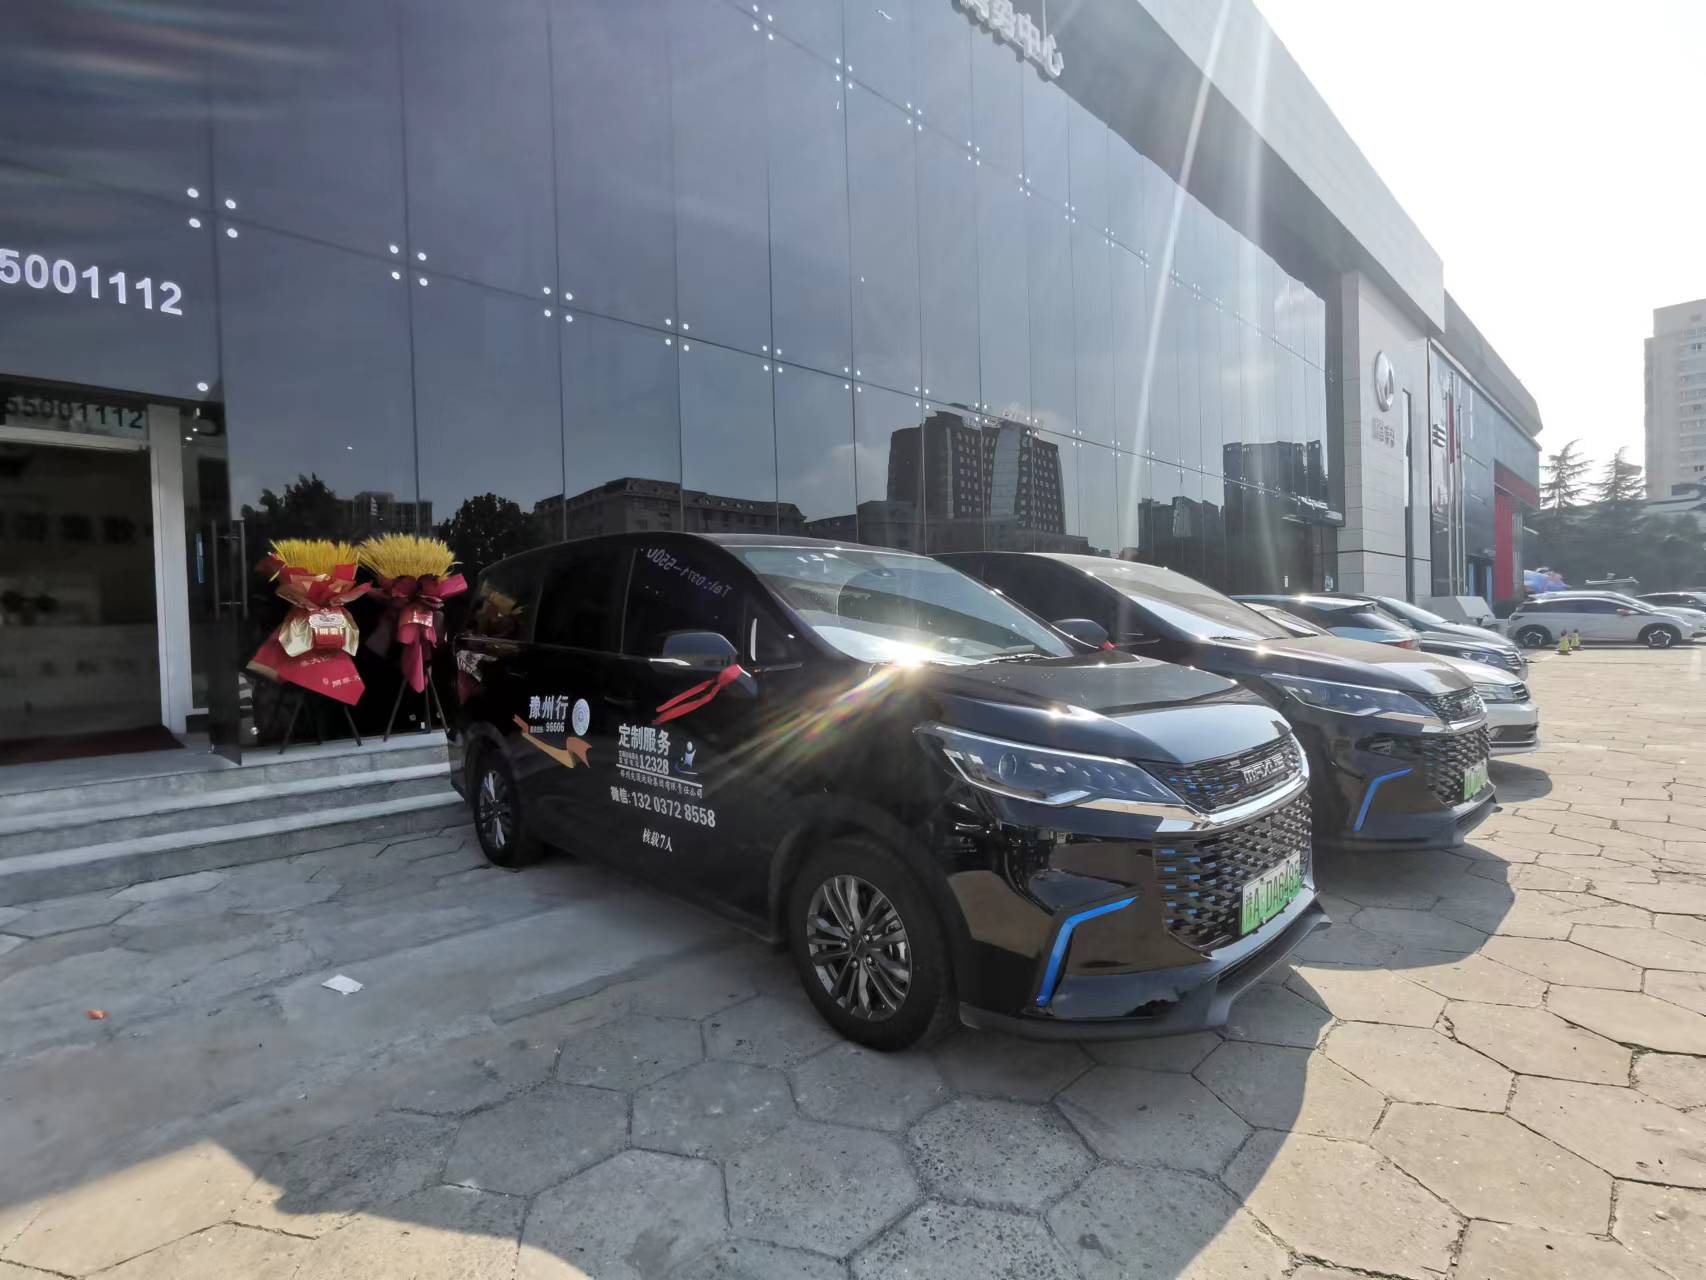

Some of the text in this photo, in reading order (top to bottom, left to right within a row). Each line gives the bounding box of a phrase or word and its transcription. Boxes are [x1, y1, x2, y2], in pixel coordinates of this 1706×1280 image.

[618, 723, 671, 756] 定制服务
[639, 754, 670, 775] 12328
[642, 828, 673, 852] 核载7人
